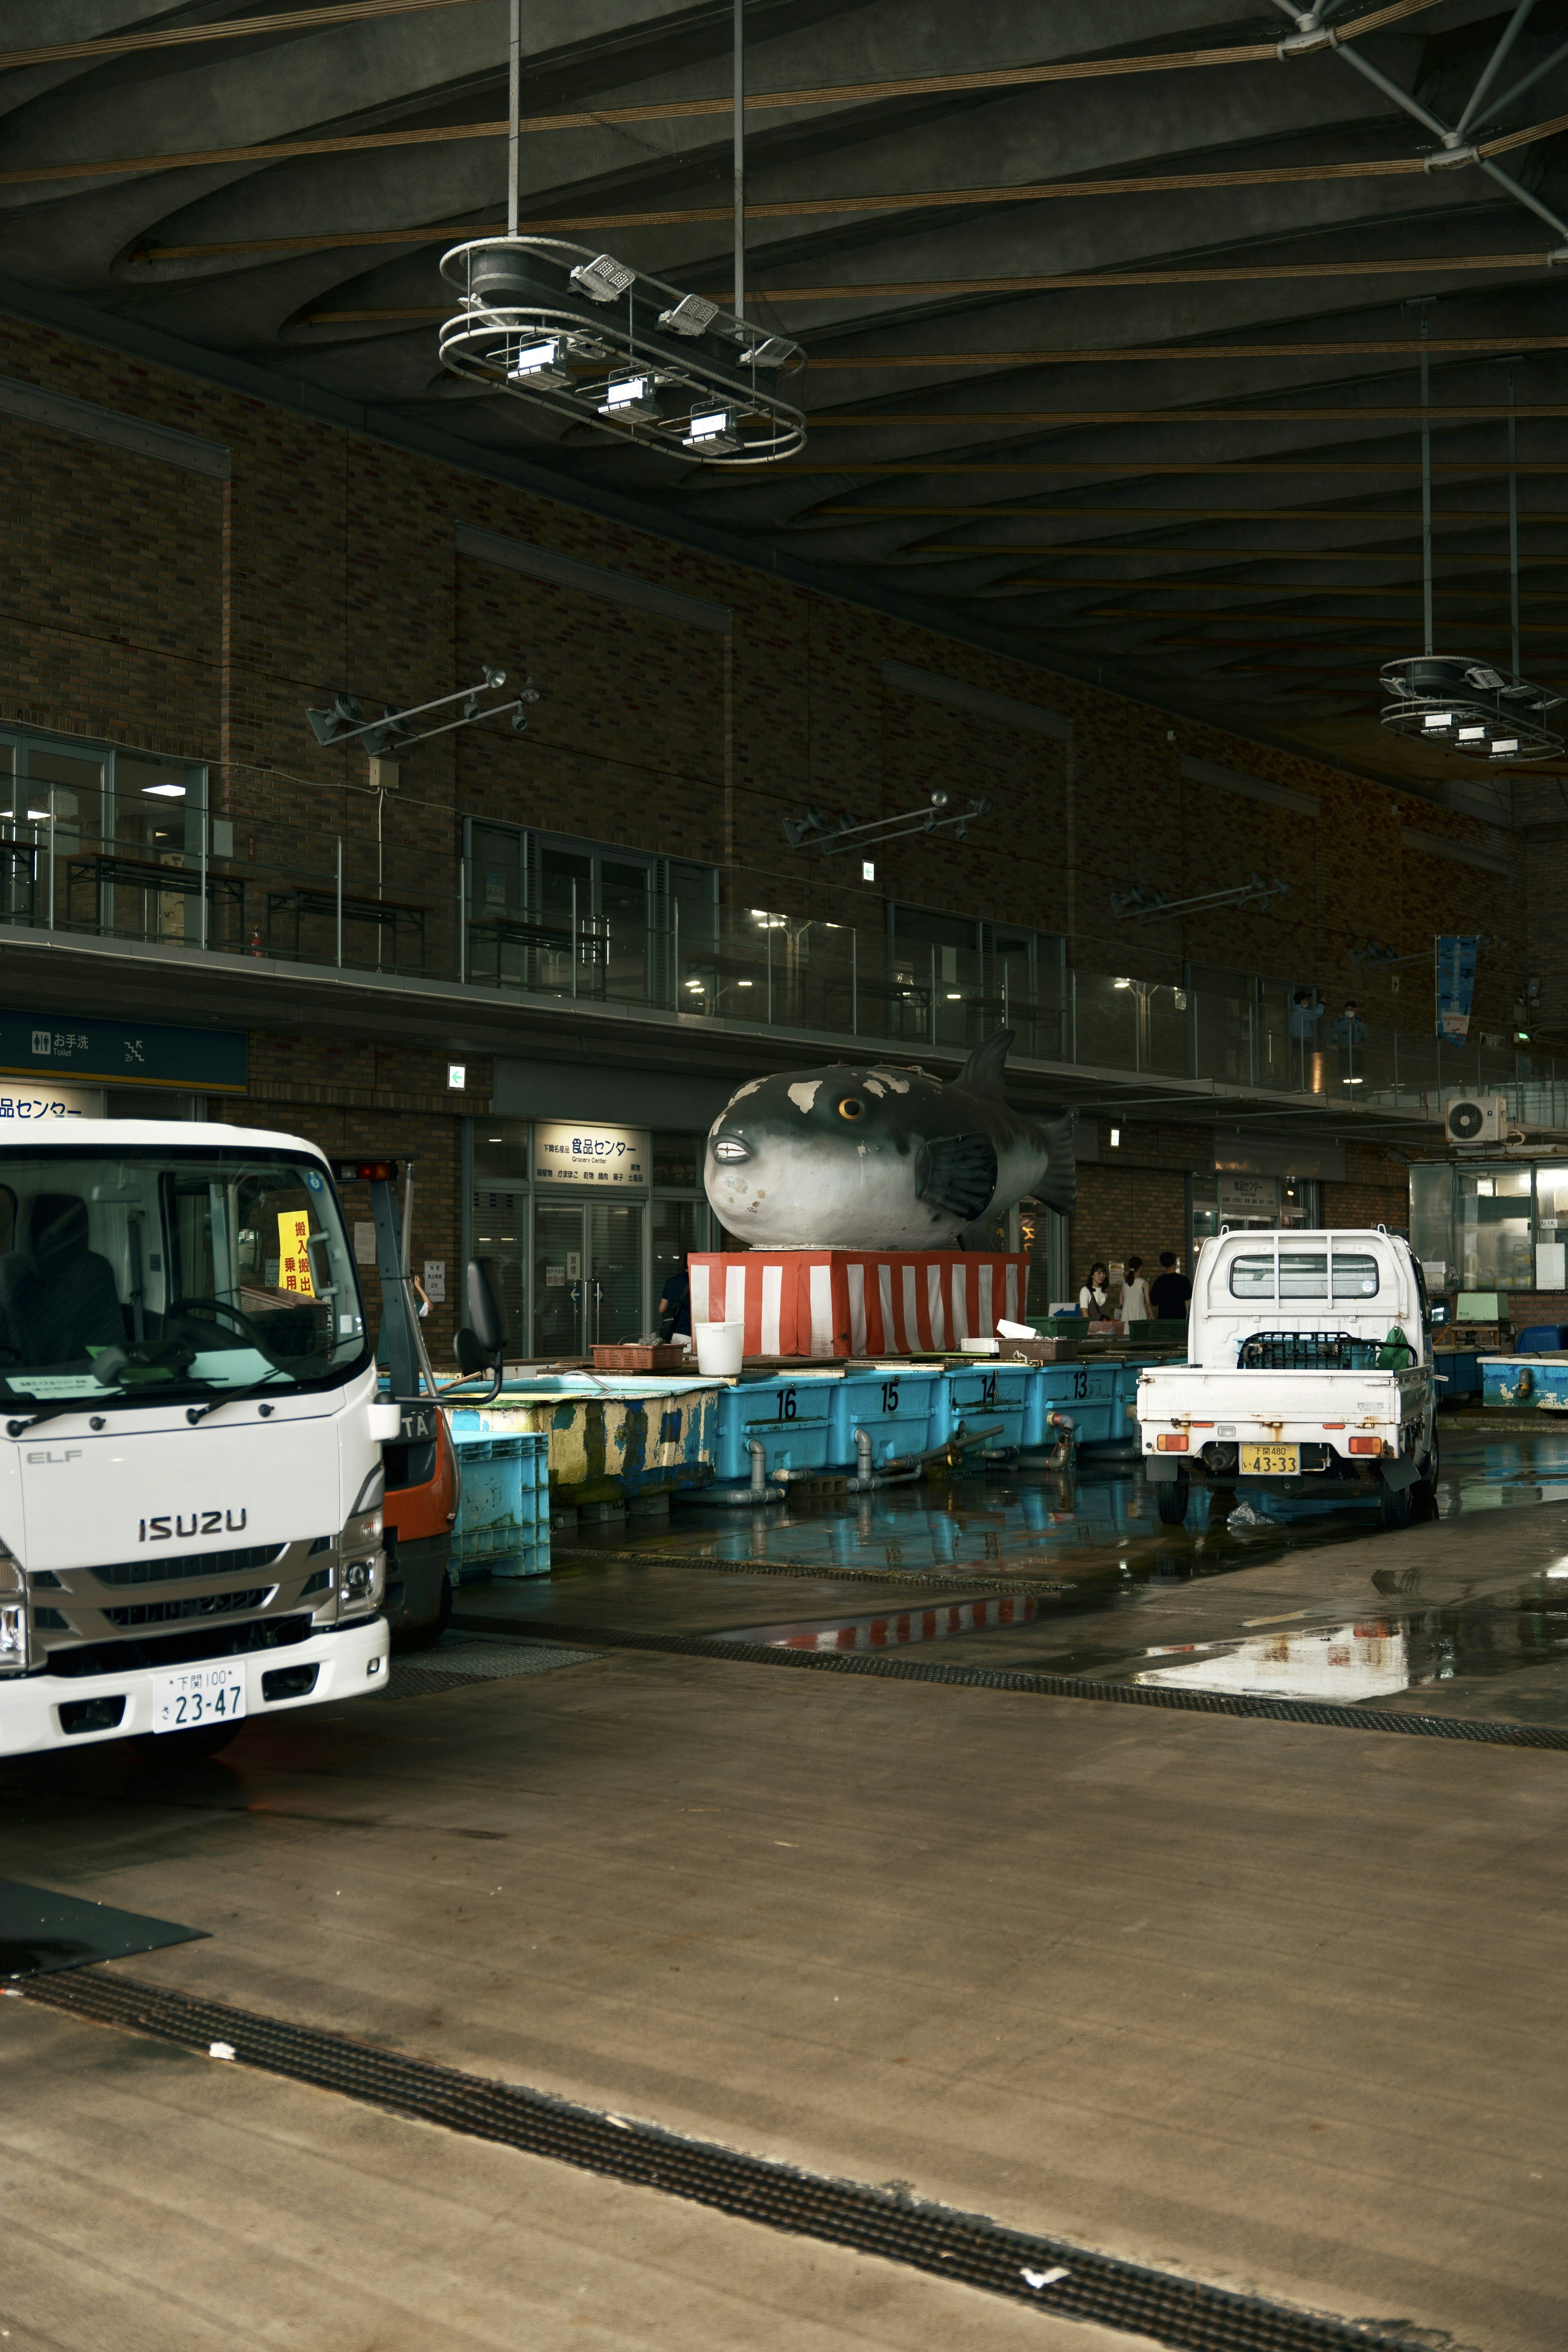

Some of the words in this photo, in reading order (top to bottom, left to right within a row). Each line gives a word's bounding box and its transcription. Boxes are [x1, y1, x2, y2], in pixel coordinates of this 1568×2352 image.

[53, 1033, 88, 1049] お手洗
[53, 1048, 71, 1057] Toilet
[544, 1144, 570, 1154] 下関名産品
[572, 1138, 636, 1156] 食品センター
[537, 1169, 552, 1177] 海産物
[295, 1221, 312, 1298] 搬入搬出
[570, 1256, 577, 1274] 禁煙
[982, 1376, 998, 1404] 14
[1074, 1372, 1087, 1399] 13
[777, 1389, 797, 1420] 16
[881, 1383, 899, 1412] 15
[27, 1450, 82, 1464] ELF
[1253, 1457, 1296, 1472] 43-33
[138, 1508, 246, 1542] ISUZU
[177, 1674, 202, 1691] 下関
[206, 1670, 226, 1687] 100
[175, 1686, 241, 1724] 23-47
